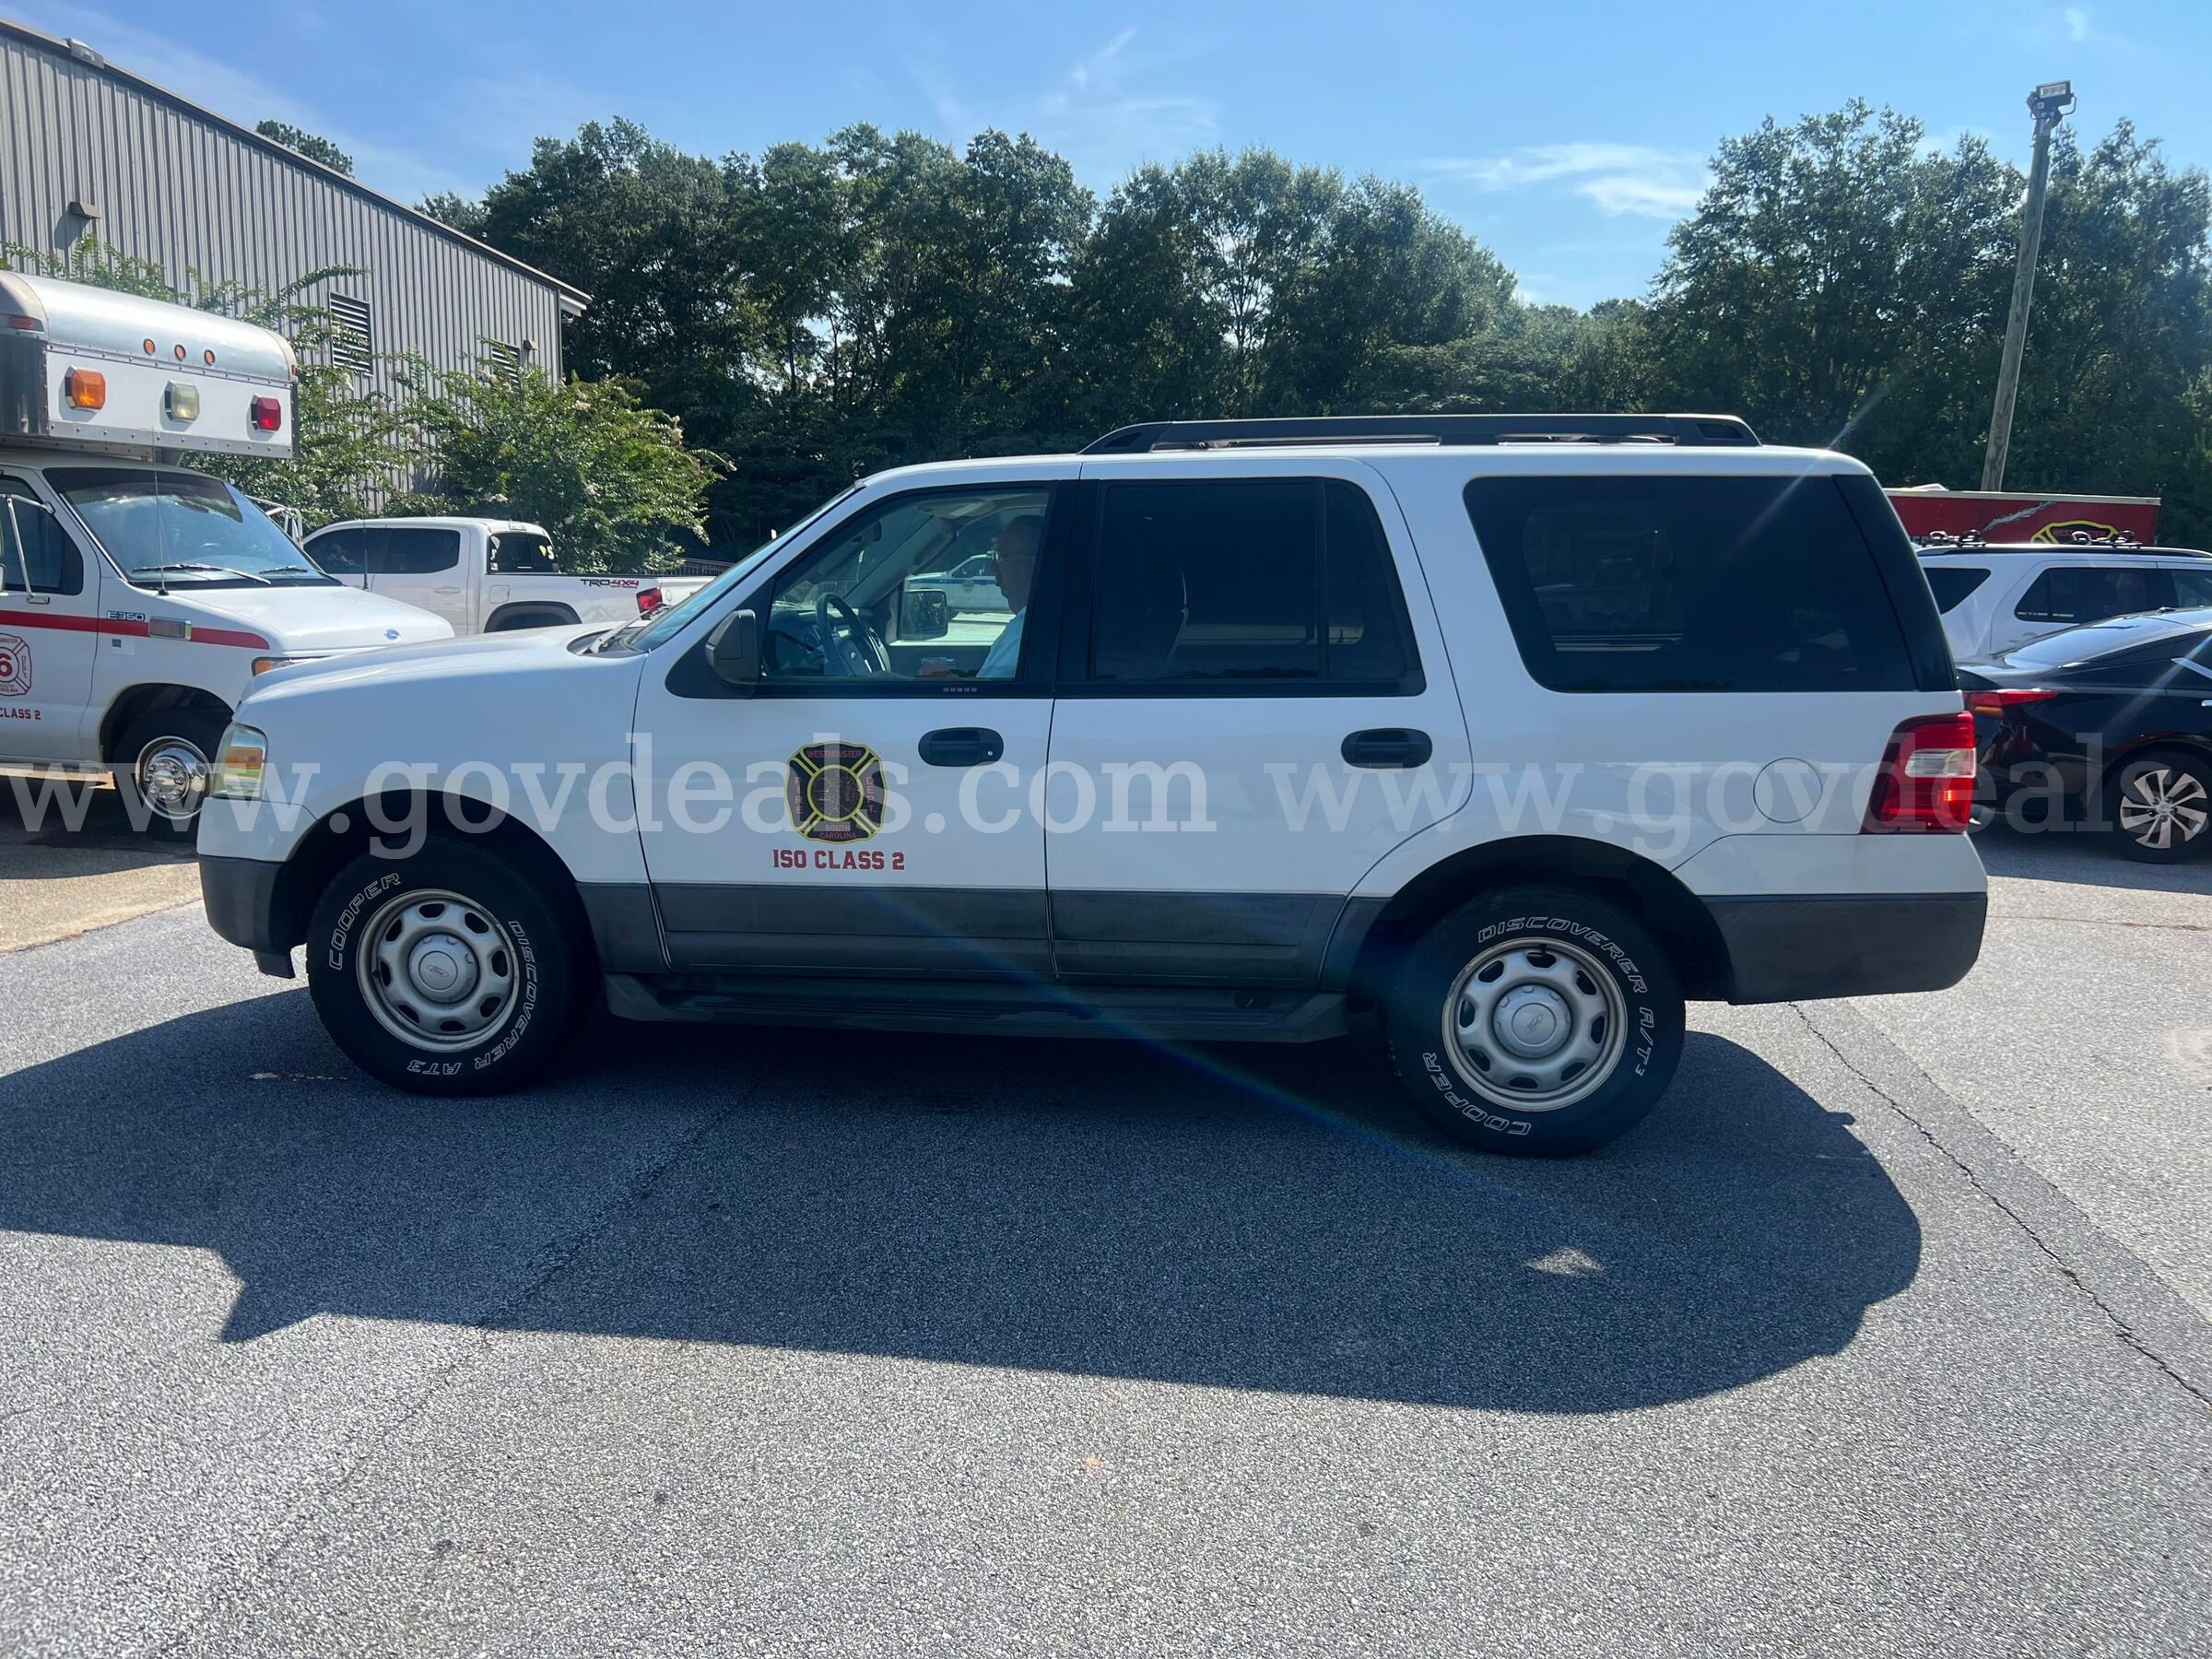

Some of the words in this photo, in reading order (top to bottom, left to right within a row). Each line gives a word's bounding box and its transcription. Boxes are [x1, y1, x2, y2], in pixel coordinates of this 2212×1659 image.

[107, 611, 145, 621] E350
[34, 710, 41, 720] 2
[806, 749, 862, 759] WESTMINSTER
[794, 777, 803, 814] FIRE
[772, 849, 806, 868] ISO
[814, 851, 885, 869] CLASS
[892, 852, 905, 870] 2
[329, 872, 402, 971] COOPER
[1477, 916, 1648, 994] DISCOVERER
[474, 921, 537, 1070] DISCOVERER
[1422, 1052, 1532, 1135] COOPER
